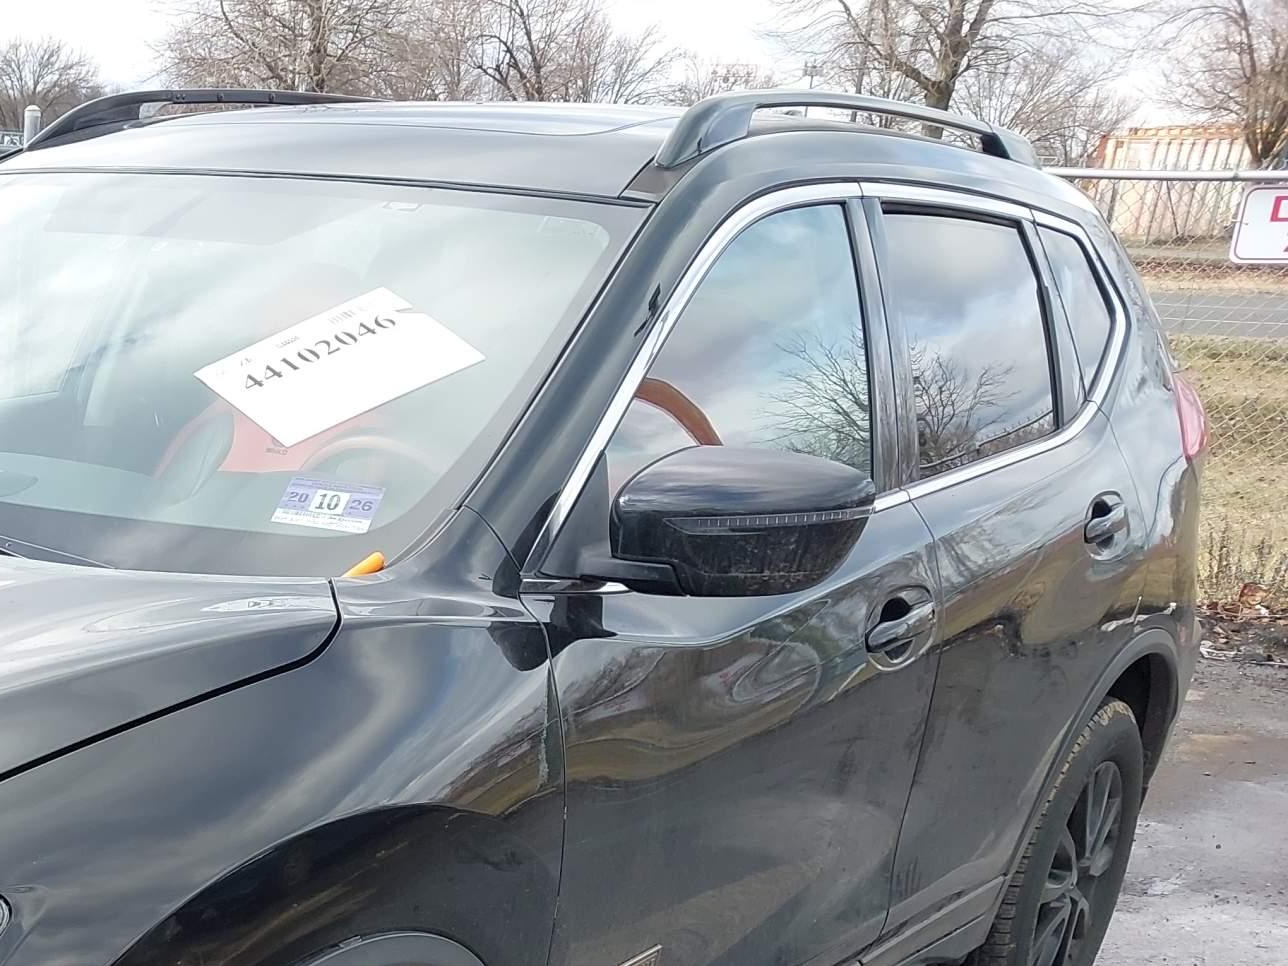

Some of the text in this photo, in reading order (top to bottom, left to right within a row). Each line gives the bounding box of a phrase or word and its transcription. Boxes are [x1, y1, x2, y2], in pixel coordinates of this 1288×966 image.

[245, 314, 396, 390] 44102046
[287, 491, 373, 512] 20 10 26
